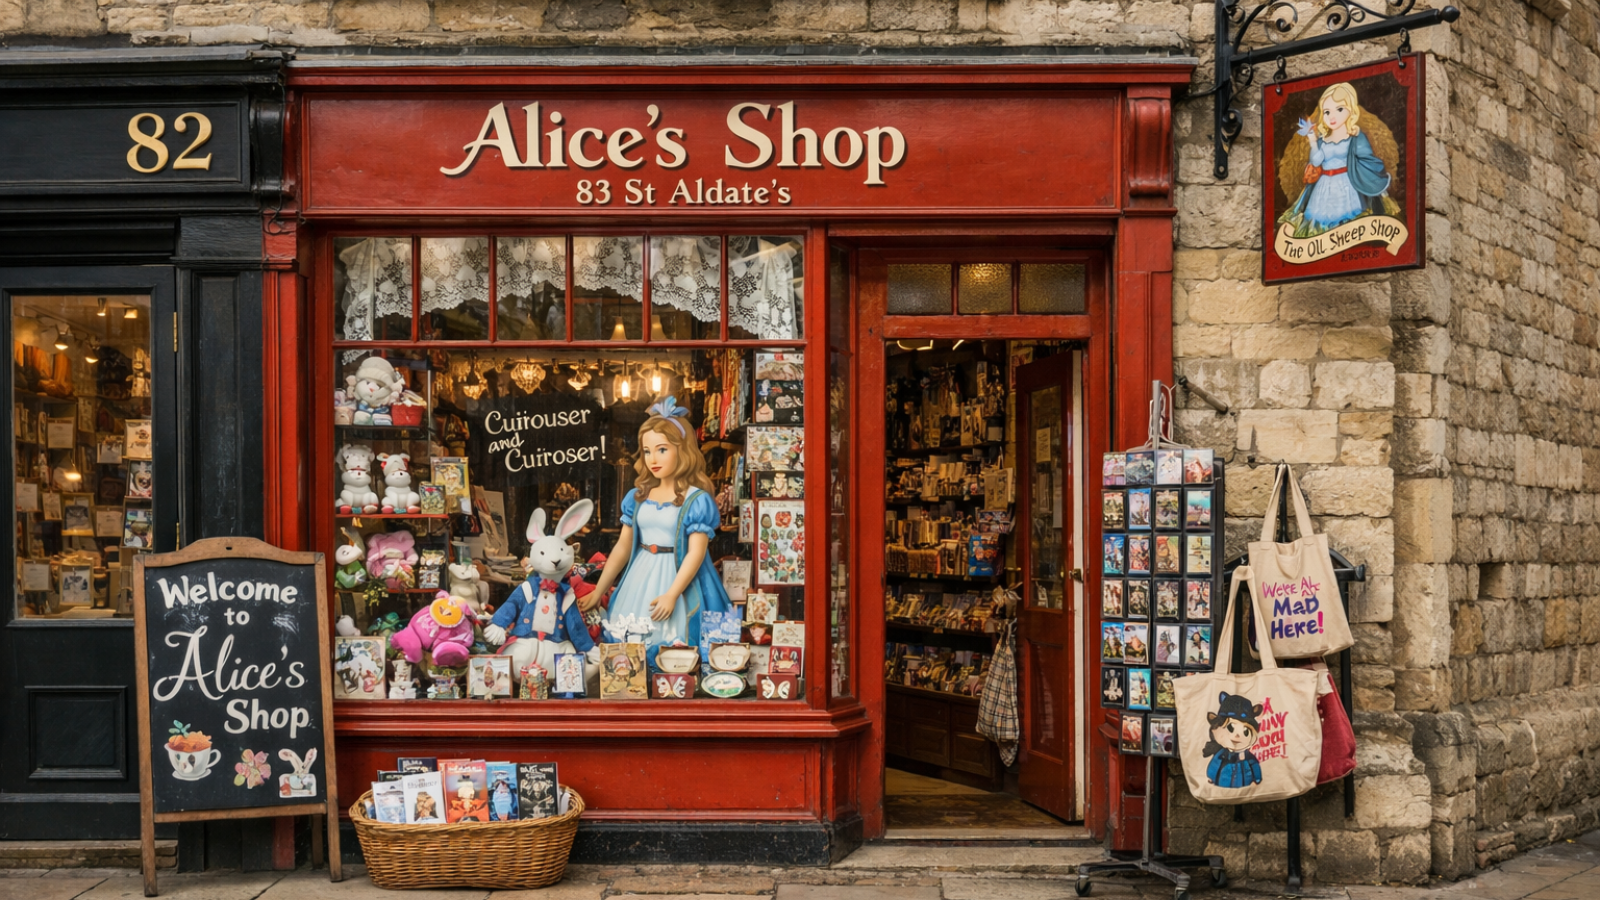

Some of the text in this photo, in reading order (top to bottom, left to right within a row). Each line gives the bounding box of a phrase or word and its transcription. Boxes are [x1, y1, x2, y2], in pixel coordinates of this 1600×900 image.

[126, 112, 213, 173] 82
[439, 100, 907, 186] Alice's Shop
[575, 177, 792, 205] 83 St Aldate's
[488, 432, 525, 454] and
[156, 571, 298, 609] Welcome
[223, 607, 250, 626] to
[153, 624, 305, 701] Alice's
[223, 698, 309, 739] Shop
